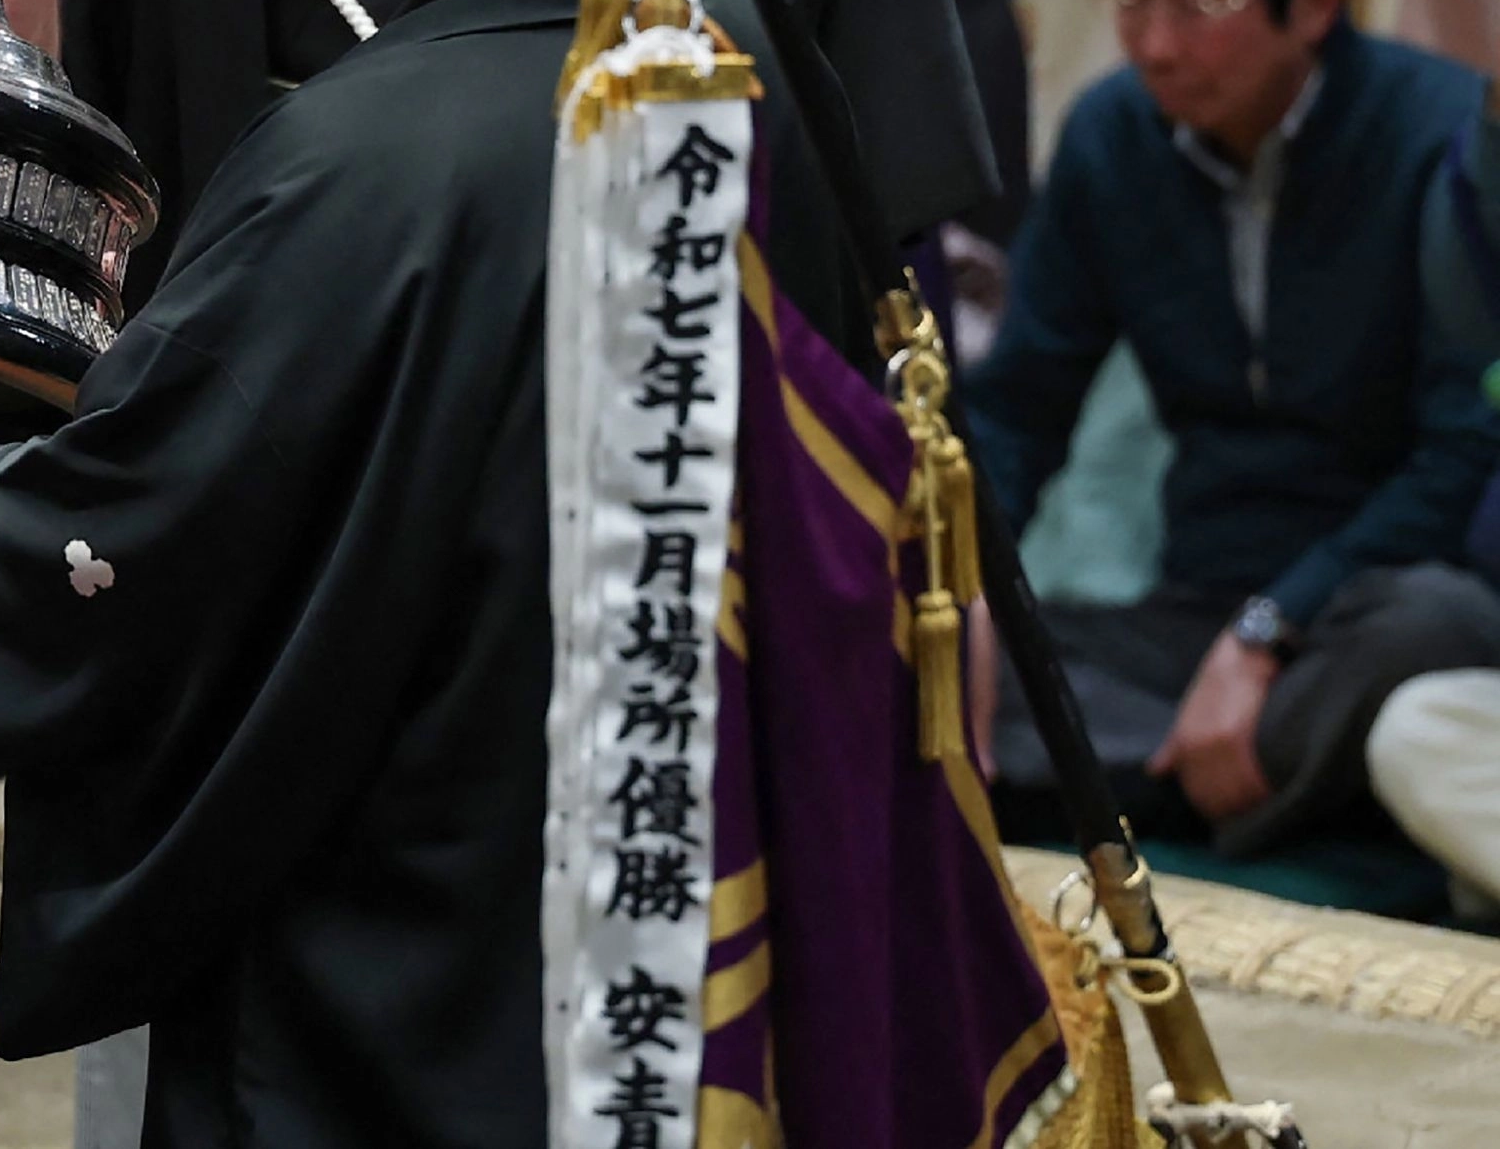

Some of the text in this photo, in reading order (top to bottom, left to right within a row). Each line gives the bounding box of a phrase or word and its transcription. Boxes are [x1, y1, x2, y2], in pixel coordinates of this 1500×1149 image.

[594, 124, 734, 1149] 令和七年十一月場所優勝 安青
